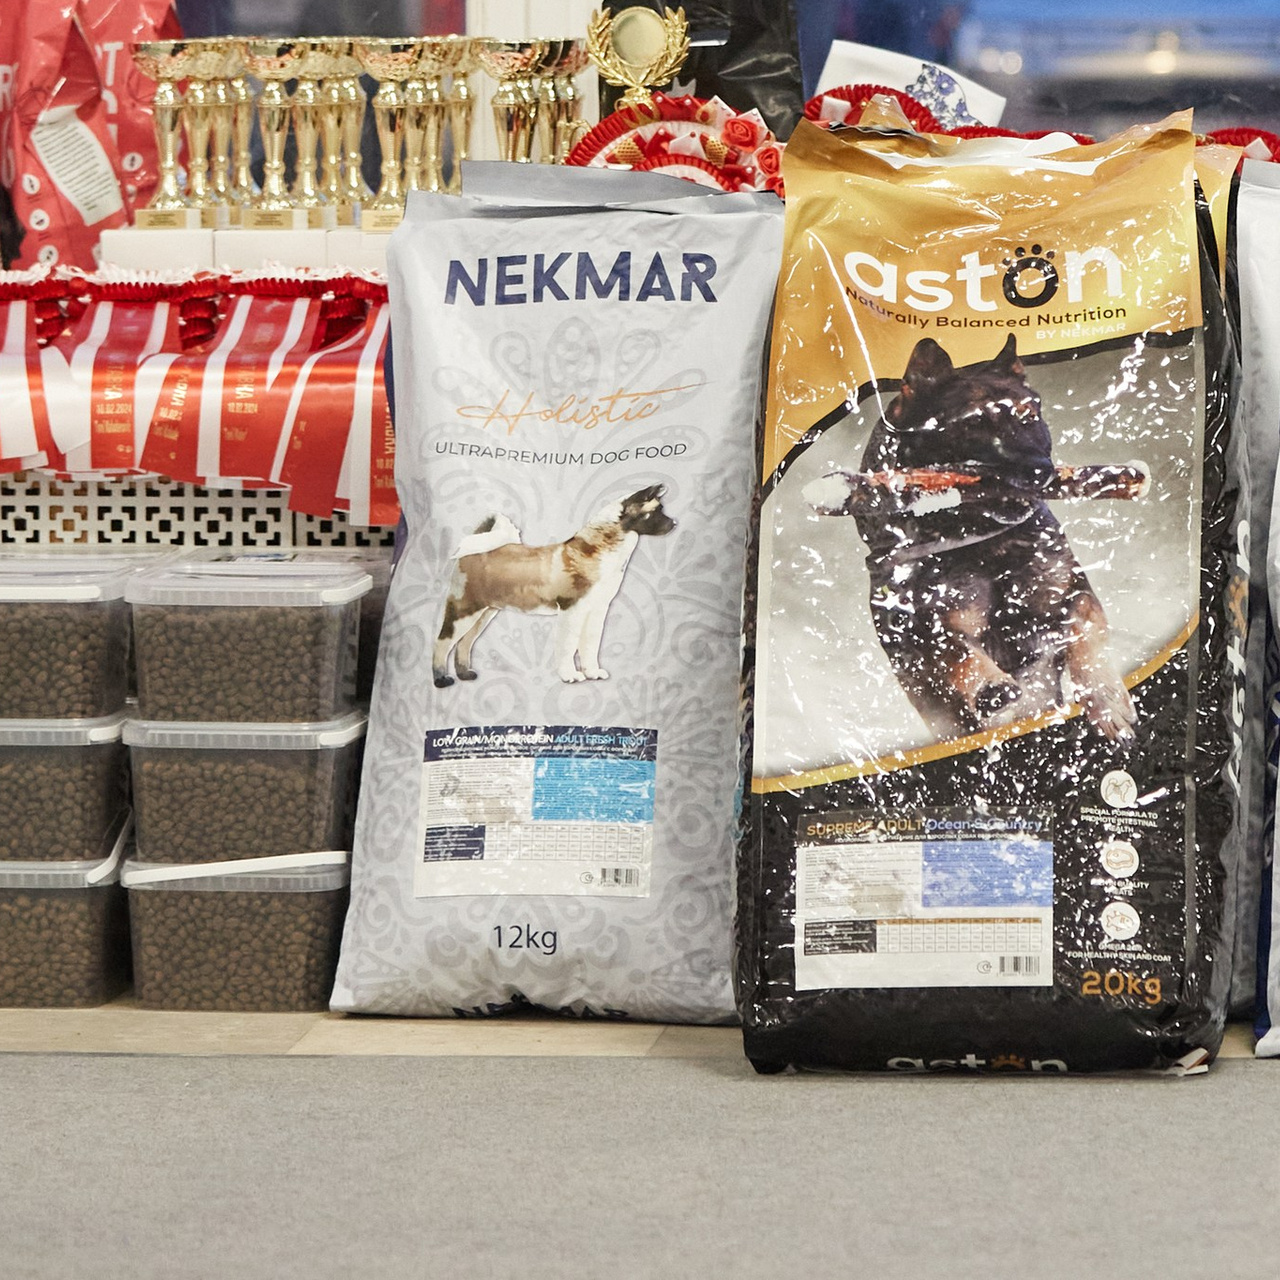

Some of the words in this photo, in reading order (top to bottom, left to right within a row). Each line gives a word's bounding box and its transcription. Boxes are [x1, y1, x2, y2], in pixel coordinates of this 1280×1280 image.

[443, 251, 718, 307] NEKMAR
[843, 243, 1123, 313] aston
[845, 286, 928, 329] Naturally
[936, 315, 1030, 329] Balanced
[1037, 304, 1126, 326] Nutrition
[1035, 328, 1056, 340] BY
[1060, 322, 1126, 338] NEKMAR
[457, 381, 714, 437] Holistic
[435, 441, 585, 465] ULTRAPREMIUM
[590, 448, 629, 465] DOG
[634, 442, 688, 460] FOOD
[554, 733, 583, 745] ADULT
[806, 821, 874, 836] SUPREME
[926, 818, 971, 831] Ocean
[493, 923, 558, 956] 12kg
[1081, 971, 1162, 1005] 20kg
